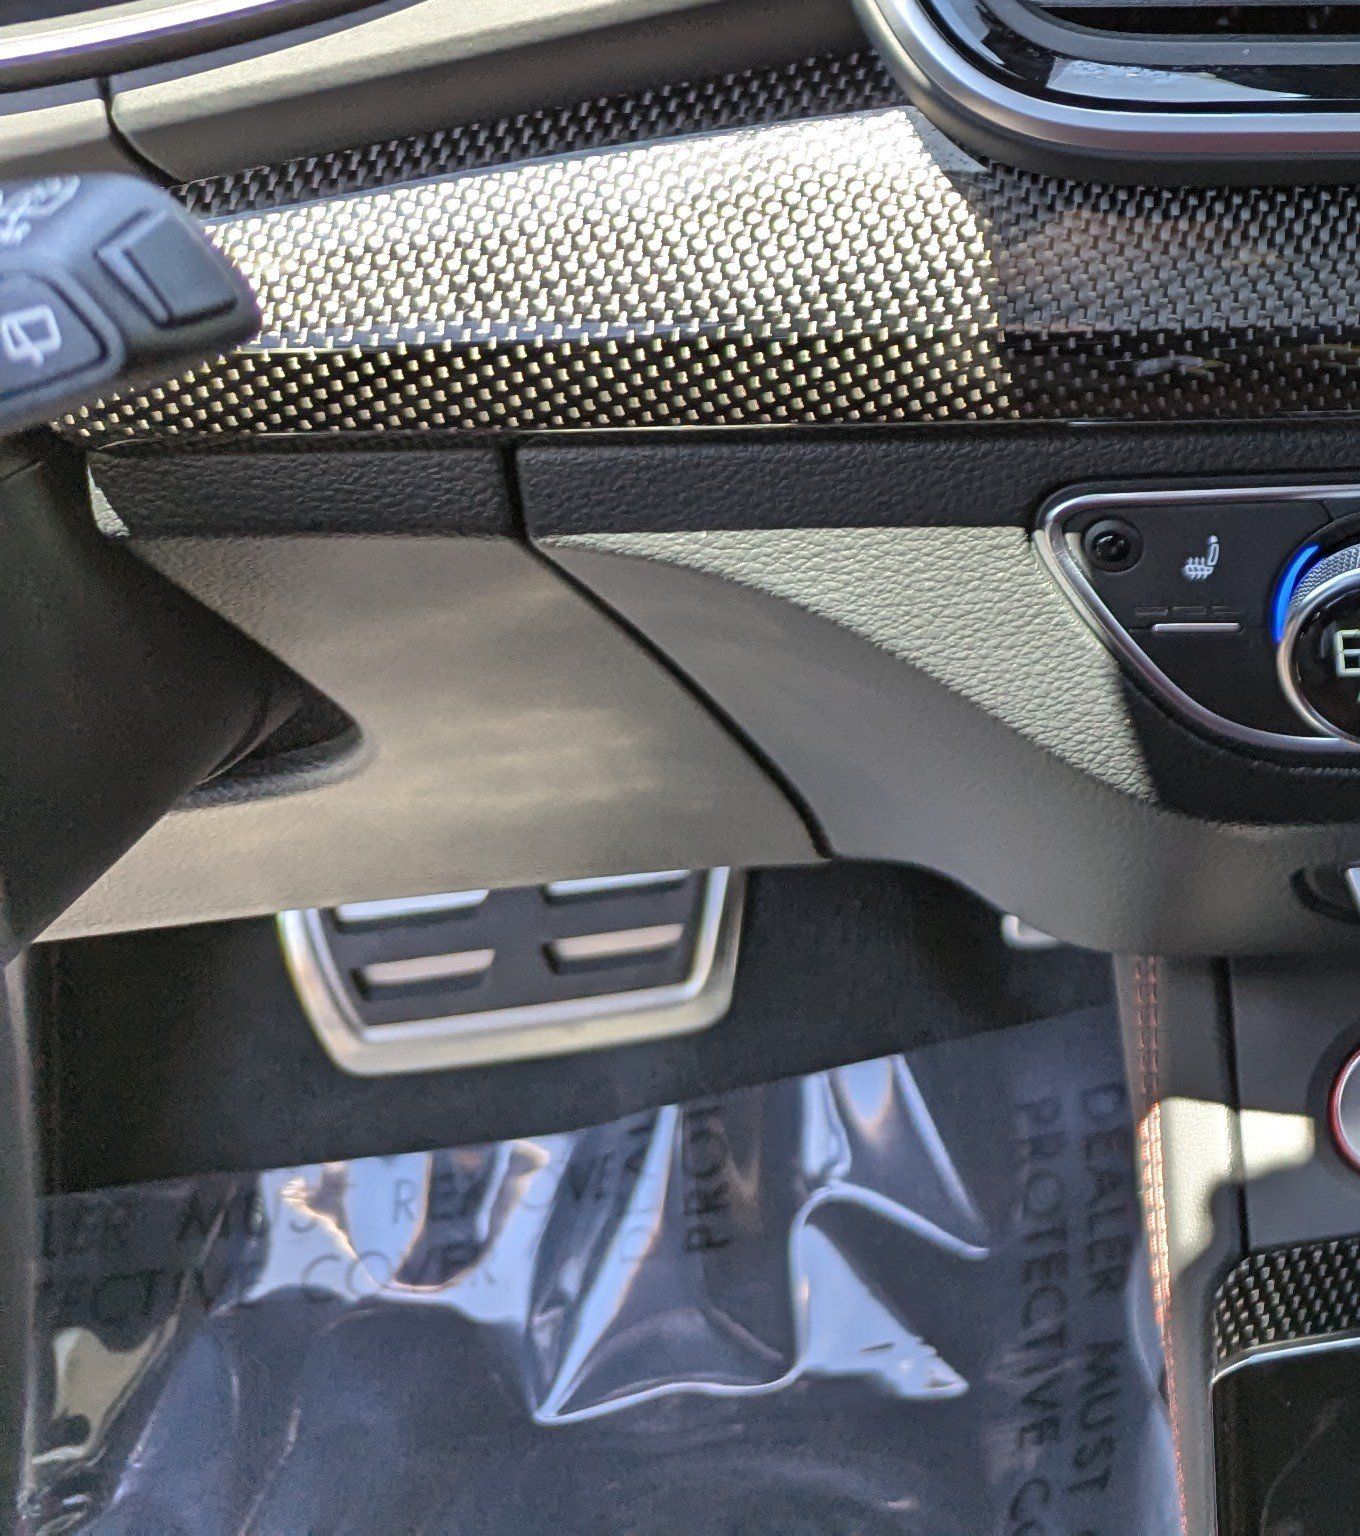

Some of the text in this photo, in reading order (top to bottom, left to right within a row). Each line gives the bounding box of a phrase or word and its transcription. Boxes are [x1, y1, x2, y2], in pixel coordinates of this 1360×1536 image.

[1014, 1096, 1069, 1450] PROTECTIVE
[1064, 1081, 1132, 1495] DEALER MUST
